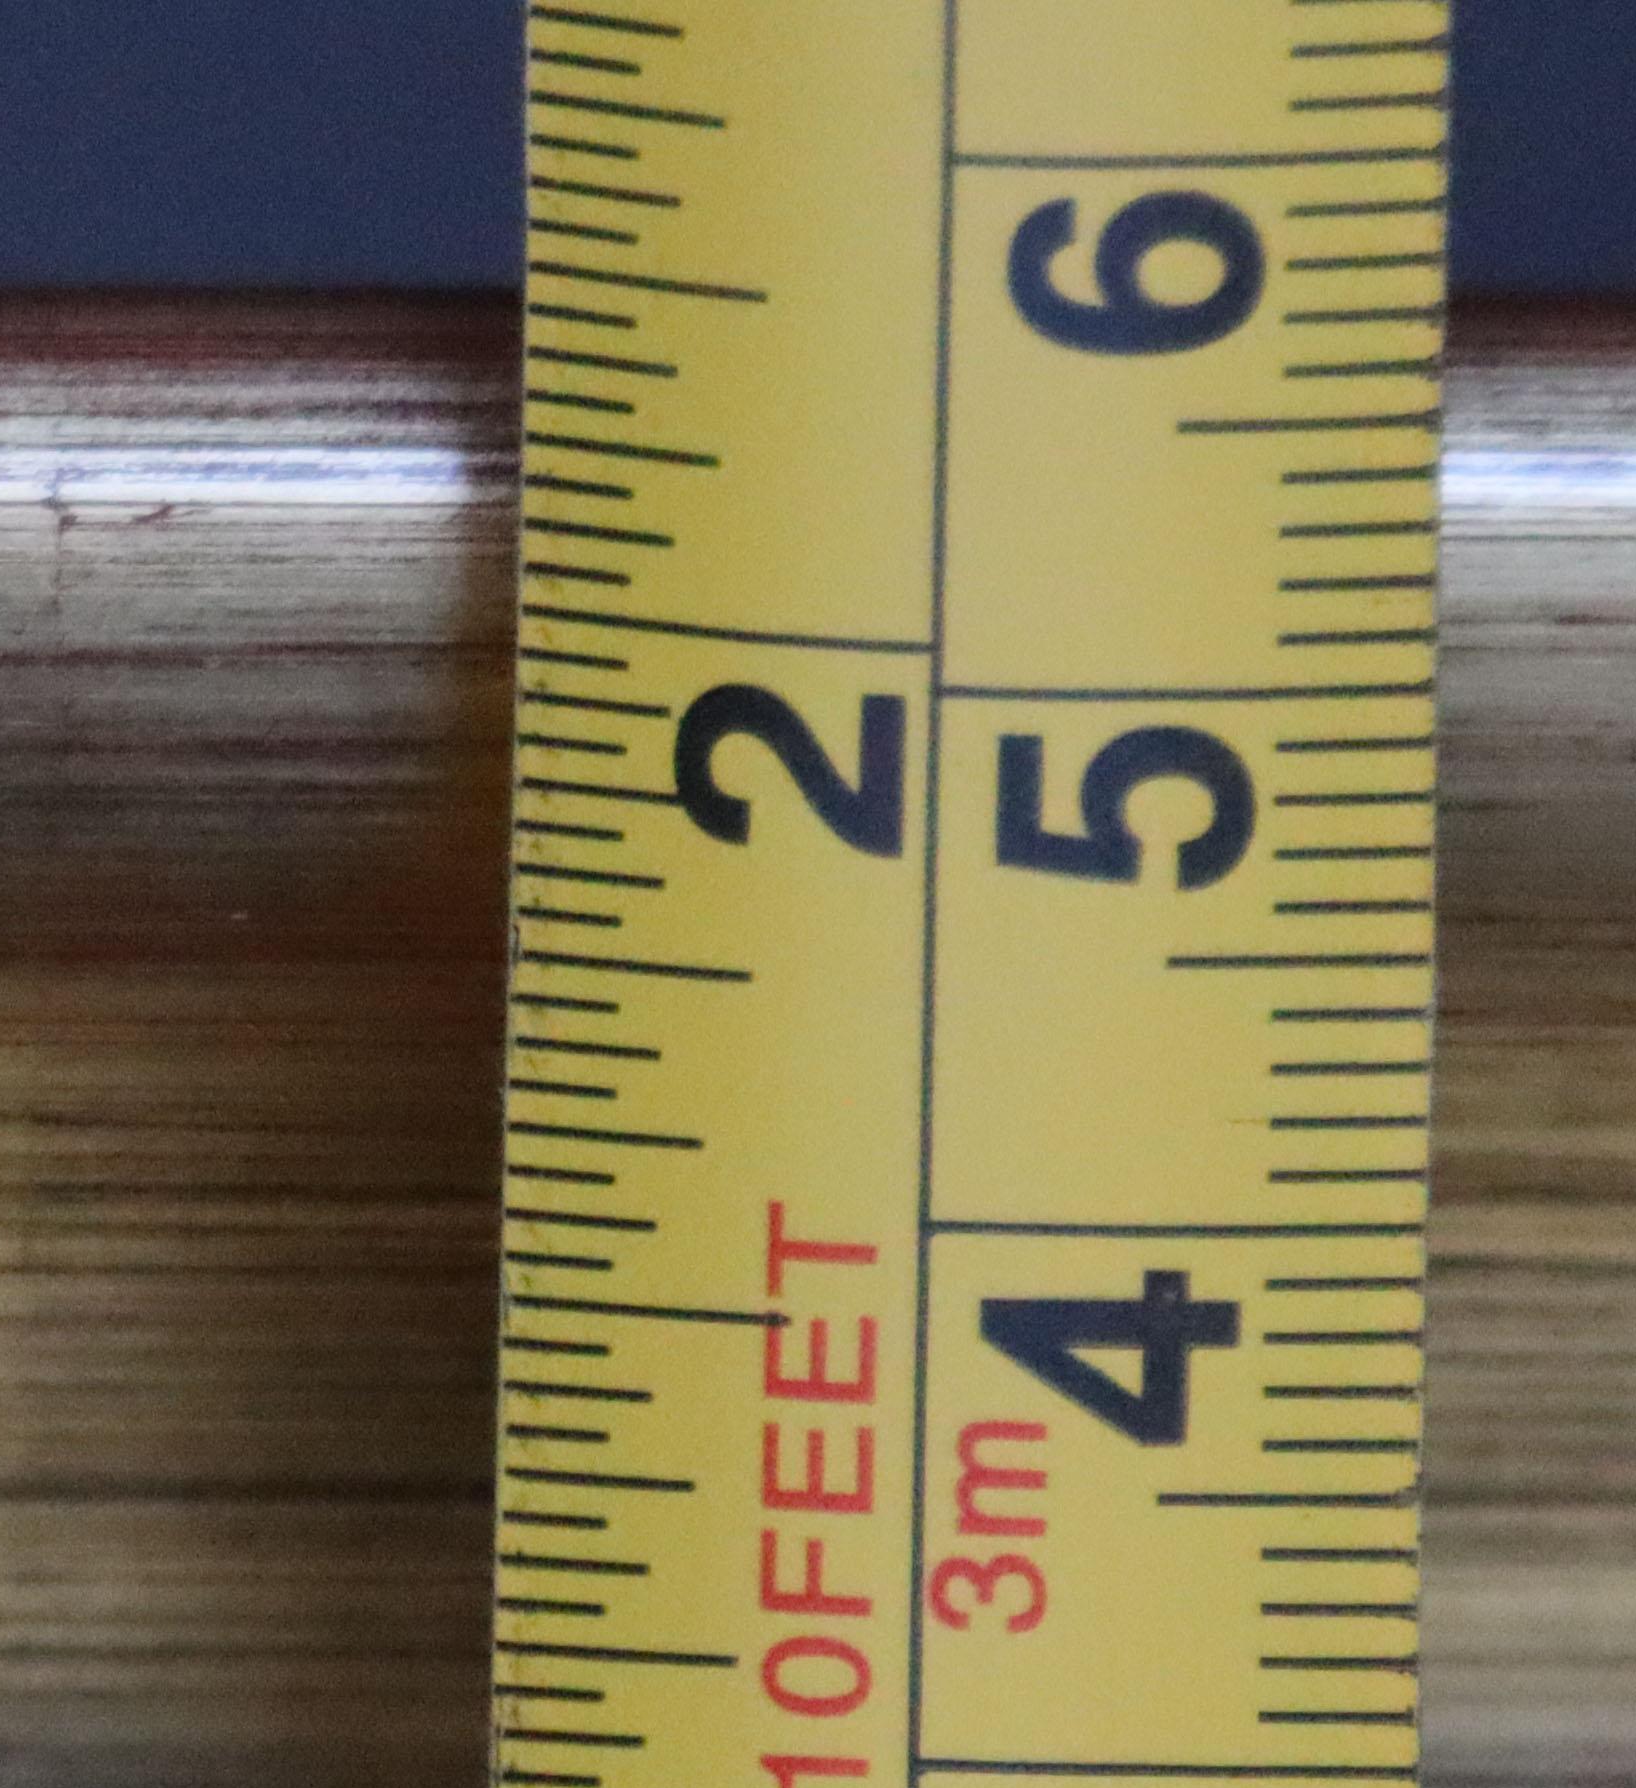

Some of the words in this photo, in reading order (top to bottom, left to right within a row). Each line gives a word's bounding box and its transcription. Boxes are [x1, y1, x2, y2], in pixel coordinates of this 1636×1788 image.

[1006, 188, 1267, 357] 6
[673, 682, 907, 860] 2
[995, 724, 1257, 892] 5
[978, 1269, 1241, 1446] 4
[928, 1418, 1048, 1634] 3m
